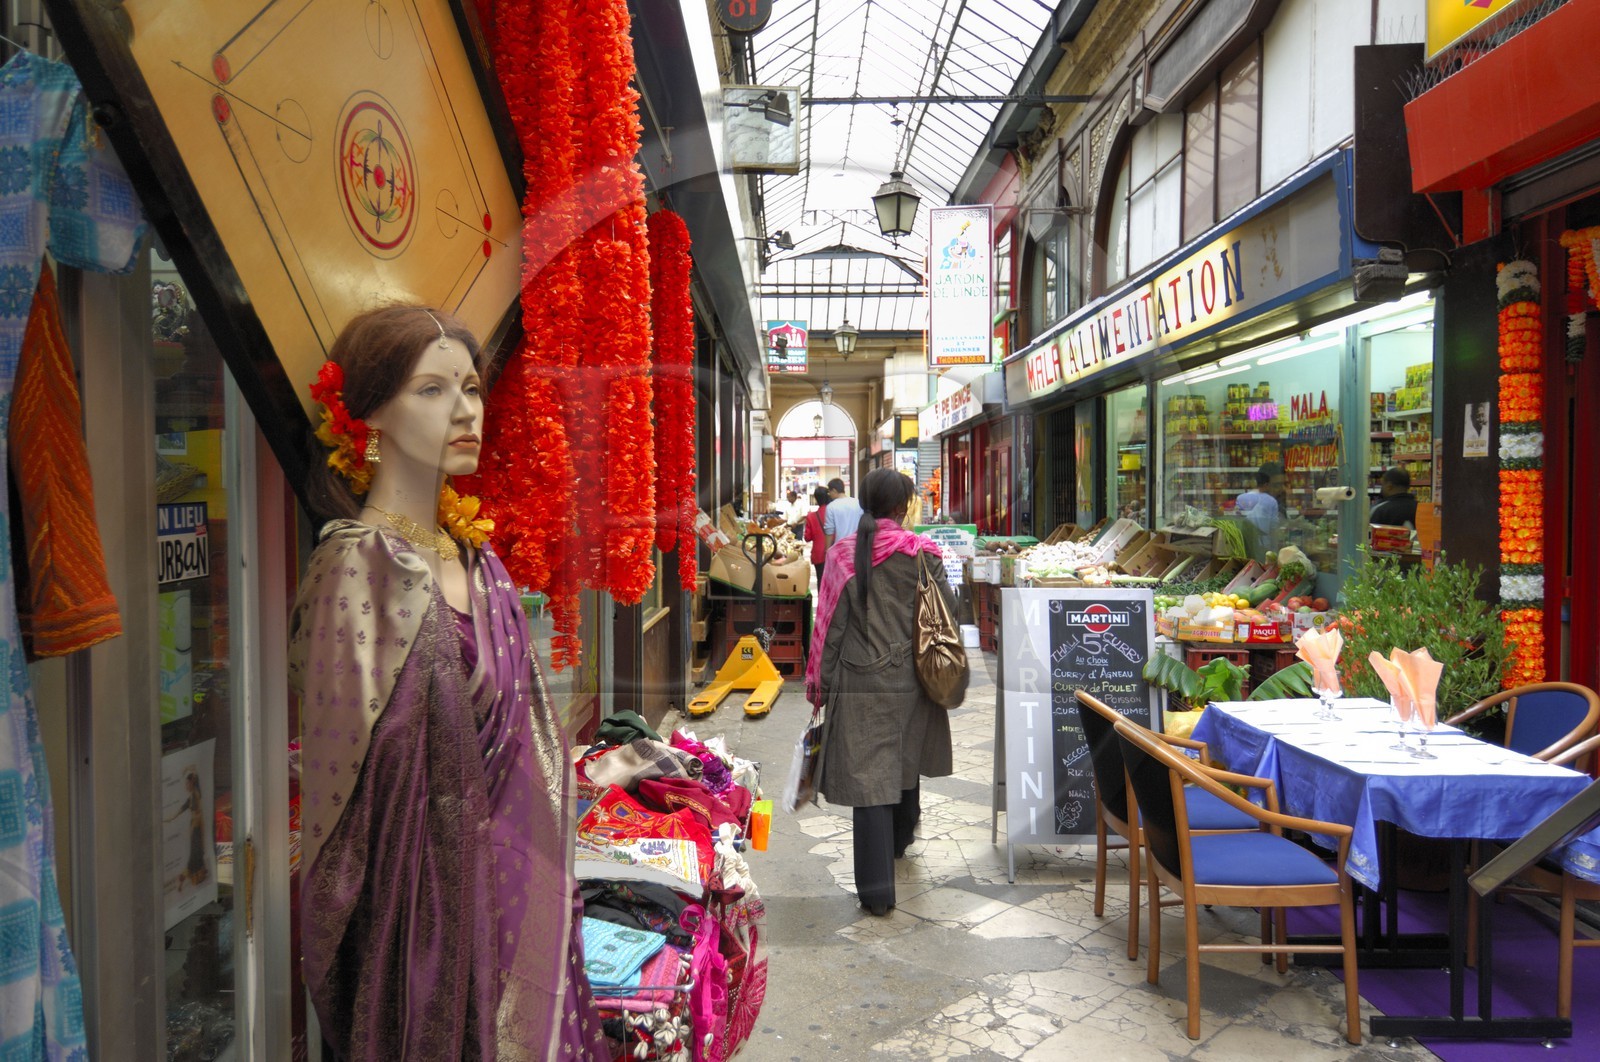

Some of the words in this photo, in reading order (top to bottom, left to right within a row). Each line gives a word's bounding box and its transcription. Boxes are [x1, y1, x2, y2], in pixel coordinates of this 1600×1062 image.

[935, 273, 985, 285] JARDIN
[933, 287, 948, 298] DE
[1026, 344, 1063, 392] MALA
[1068, 240, 1245, 375] ALIMENTATION
[1291, 390, 1328, 420] MALA
[173, 506, 203, 529] LIEU
[1070, 614, 1126, 623] MARTINI
[1050, 633, 1080, 662] THALI
[1102, 632, 1143, 663] CURRY
[1090, 683, 1100, 692] de
[1102, 681, 1137, 692] POULET
[1105, 694, 1141, 703] POISSON
[1012, 600, 1043, 825] MARTINI
[1067, 768, 1083, 776] RIZ
